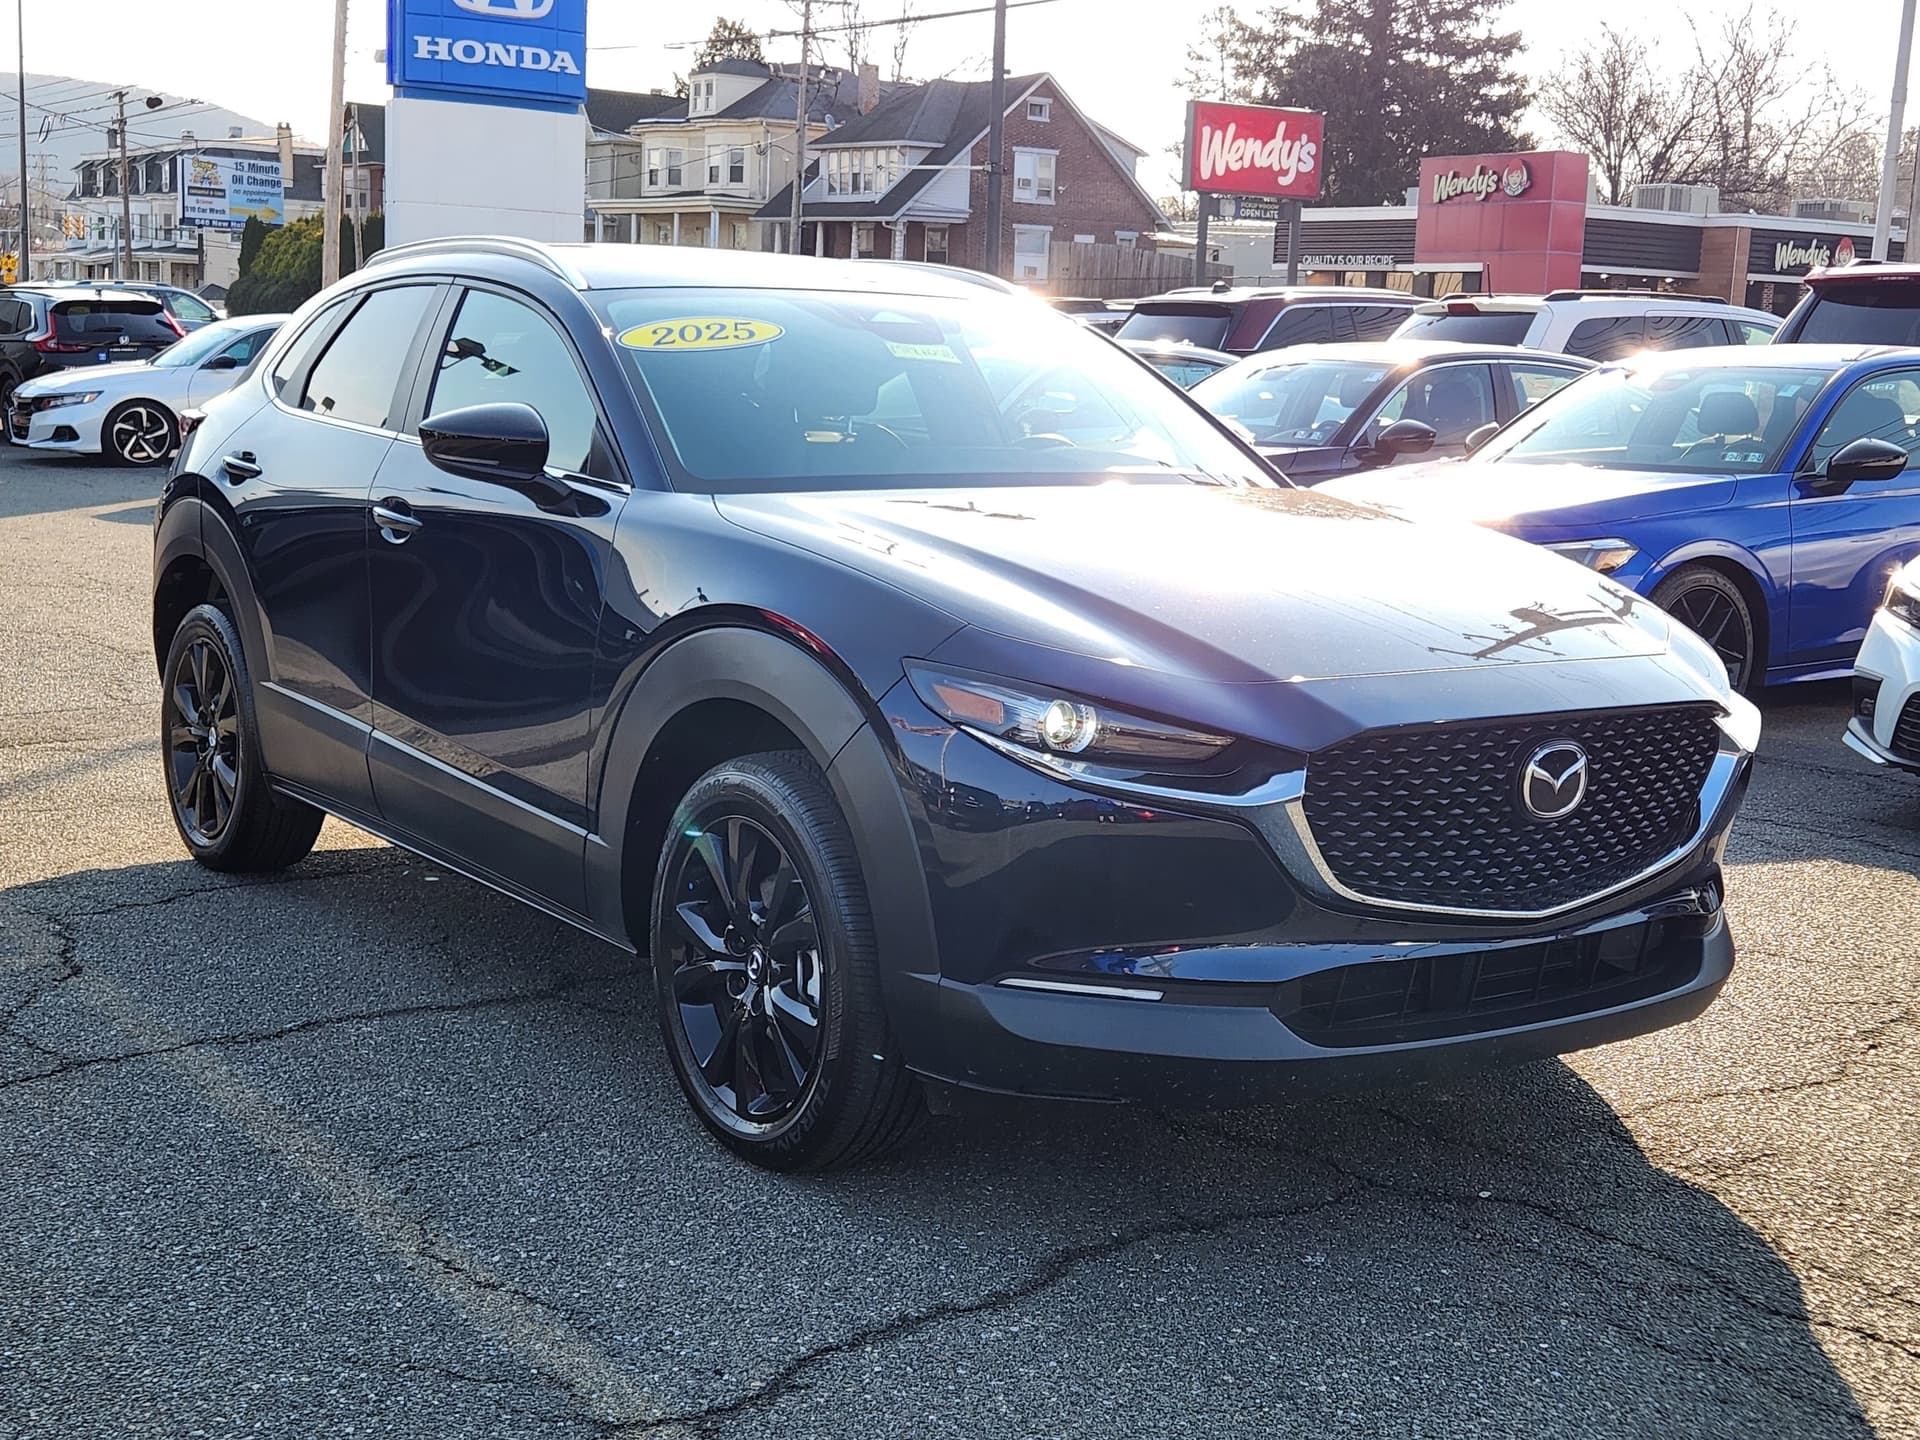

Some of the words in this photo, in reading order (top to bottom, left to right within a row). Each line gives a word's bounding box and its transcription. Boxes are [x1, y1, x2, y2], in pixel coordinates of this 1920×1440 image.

[413, 35, 581, 75] HONDA
[1200, 120, 1317, 186] Wendy's
[234, 161, 245, 172] 15
[247, 162, 280, 175] Minute
[231, 174, 244, 185] Oil
[246, 175, 282, 188] Change
[1433, 164, 1498, 204] Wendy's
[197, 206, 208, 214] Car
[209, 207, 226, 215] Wash
[1240, 208, 1260, 217] OPEN
[1261, 210, 1279, 219] LATE
[212, 219, 229, 227] New
[1302, 254, 1337, 265] QUALITY
[1338, 255, 1345, 265] IS
[1346, 255, 1364, 265] OUR
[1365, 255, 1394, 265] RECIPE
[1774, 238, 1830, 272] Wendy's
[651, 321, 756, 347] 2025
